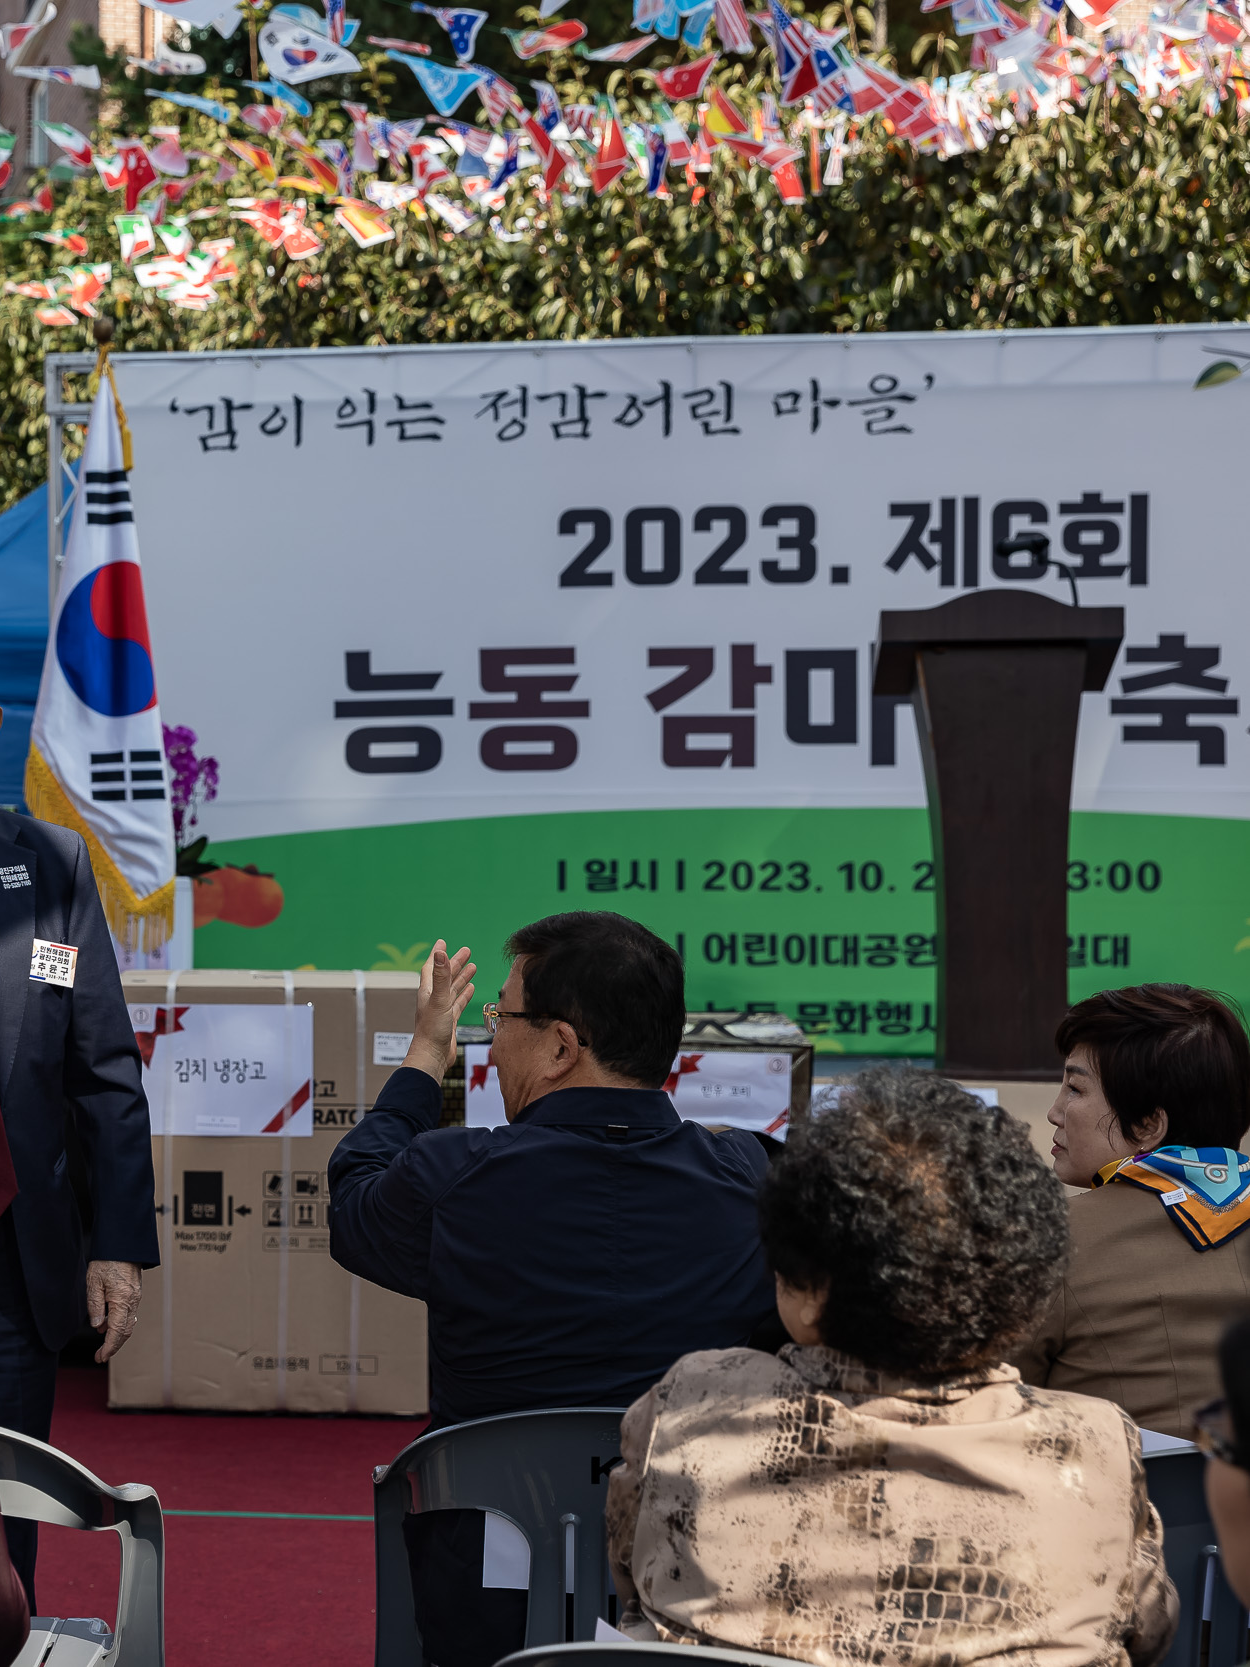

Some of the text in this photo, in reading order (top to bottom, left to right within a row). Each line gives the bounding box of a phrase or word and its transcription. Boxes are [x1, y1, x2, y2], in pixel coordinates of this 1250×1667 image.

[336, 387, 446, 446] 익는
[475, 380, 741, 442] 정감어린
[558, 492, 1149, 589] 2023. 제6회
[334, 632, 1250, 775] 능동 감마 축
[584, 858, 659, 894] 일시
[702, 860, 825, 893] 2023.
[837, 861, 896, 893] 10.
[913, 860, 935, 893] 2
[1067, 860, 1162, 893] 3:00
[702, 932, 937, 968] 어린이대공원
[175, 1058, 267, 1084] 김치 냉장고
